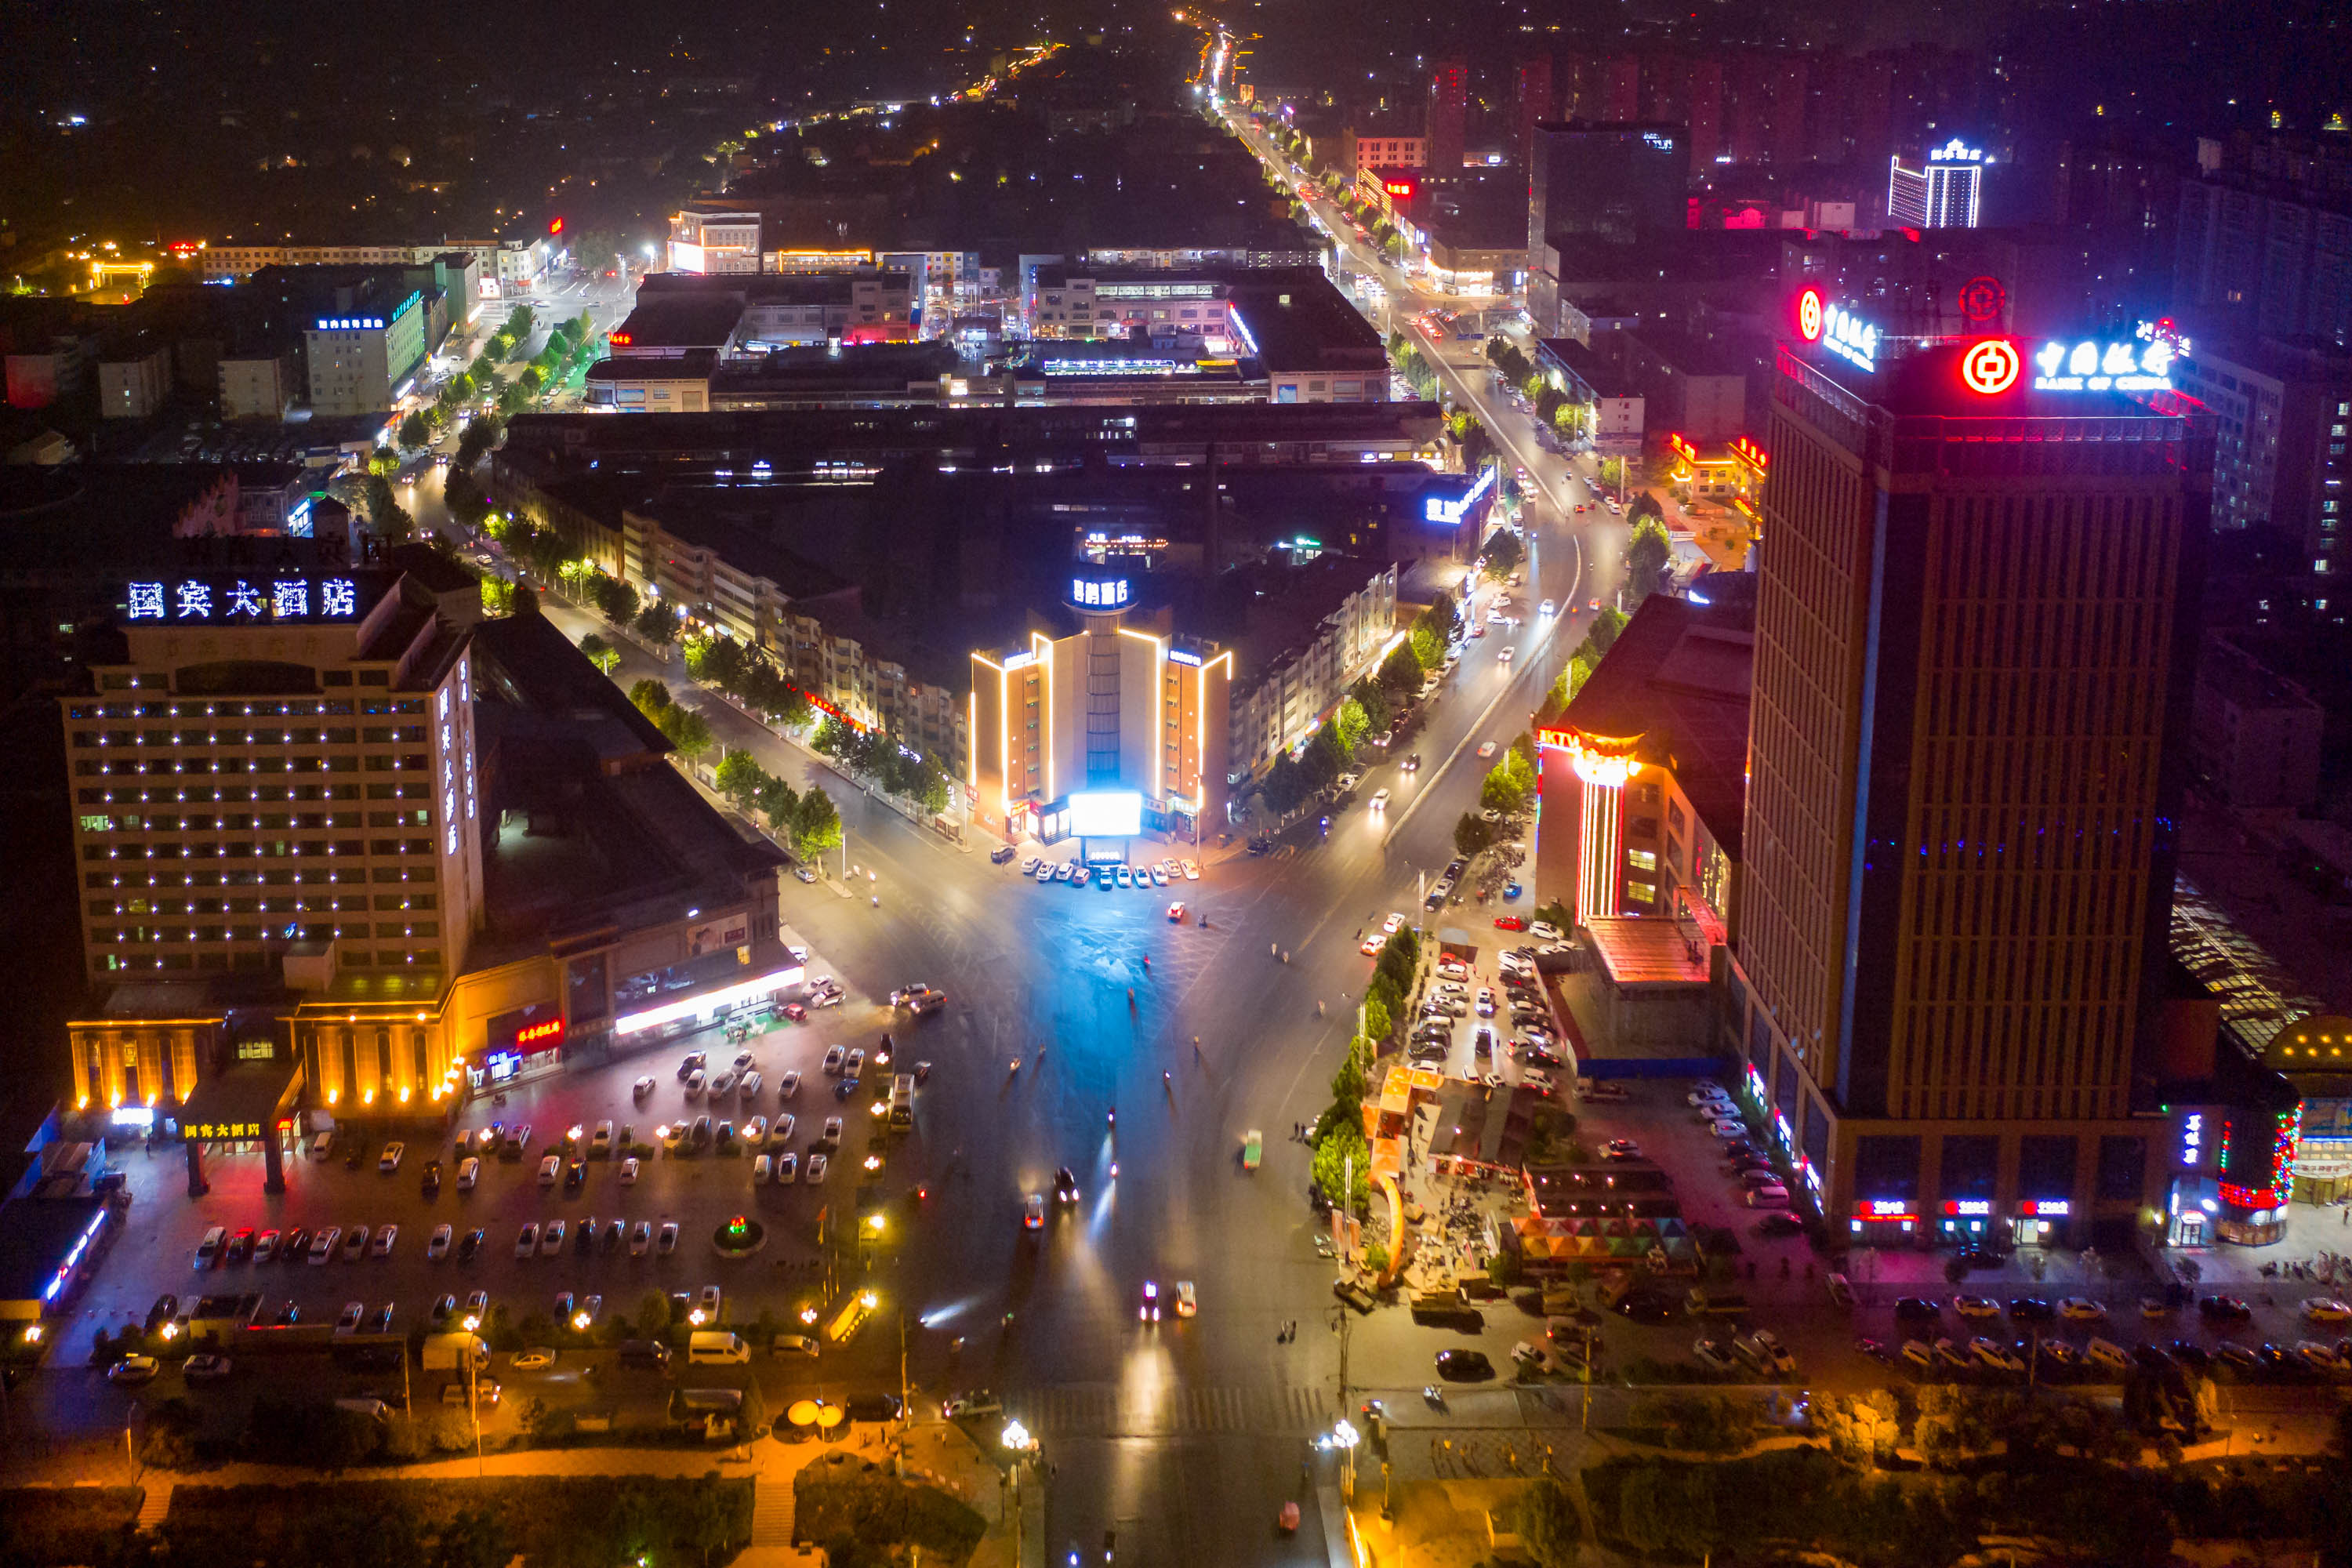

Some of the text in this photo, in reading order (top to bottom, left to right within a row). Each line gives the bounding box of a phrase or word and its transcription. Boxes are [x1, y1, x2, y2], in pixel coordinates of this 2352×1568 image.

[2037, 340, 2175, 376] 中国银行
[2034, 377, 2083, 390] BANK
[129, 578, 355, 619] 国宾大酒店
[184, 1123, 260, 1138] 国宾大酒店
